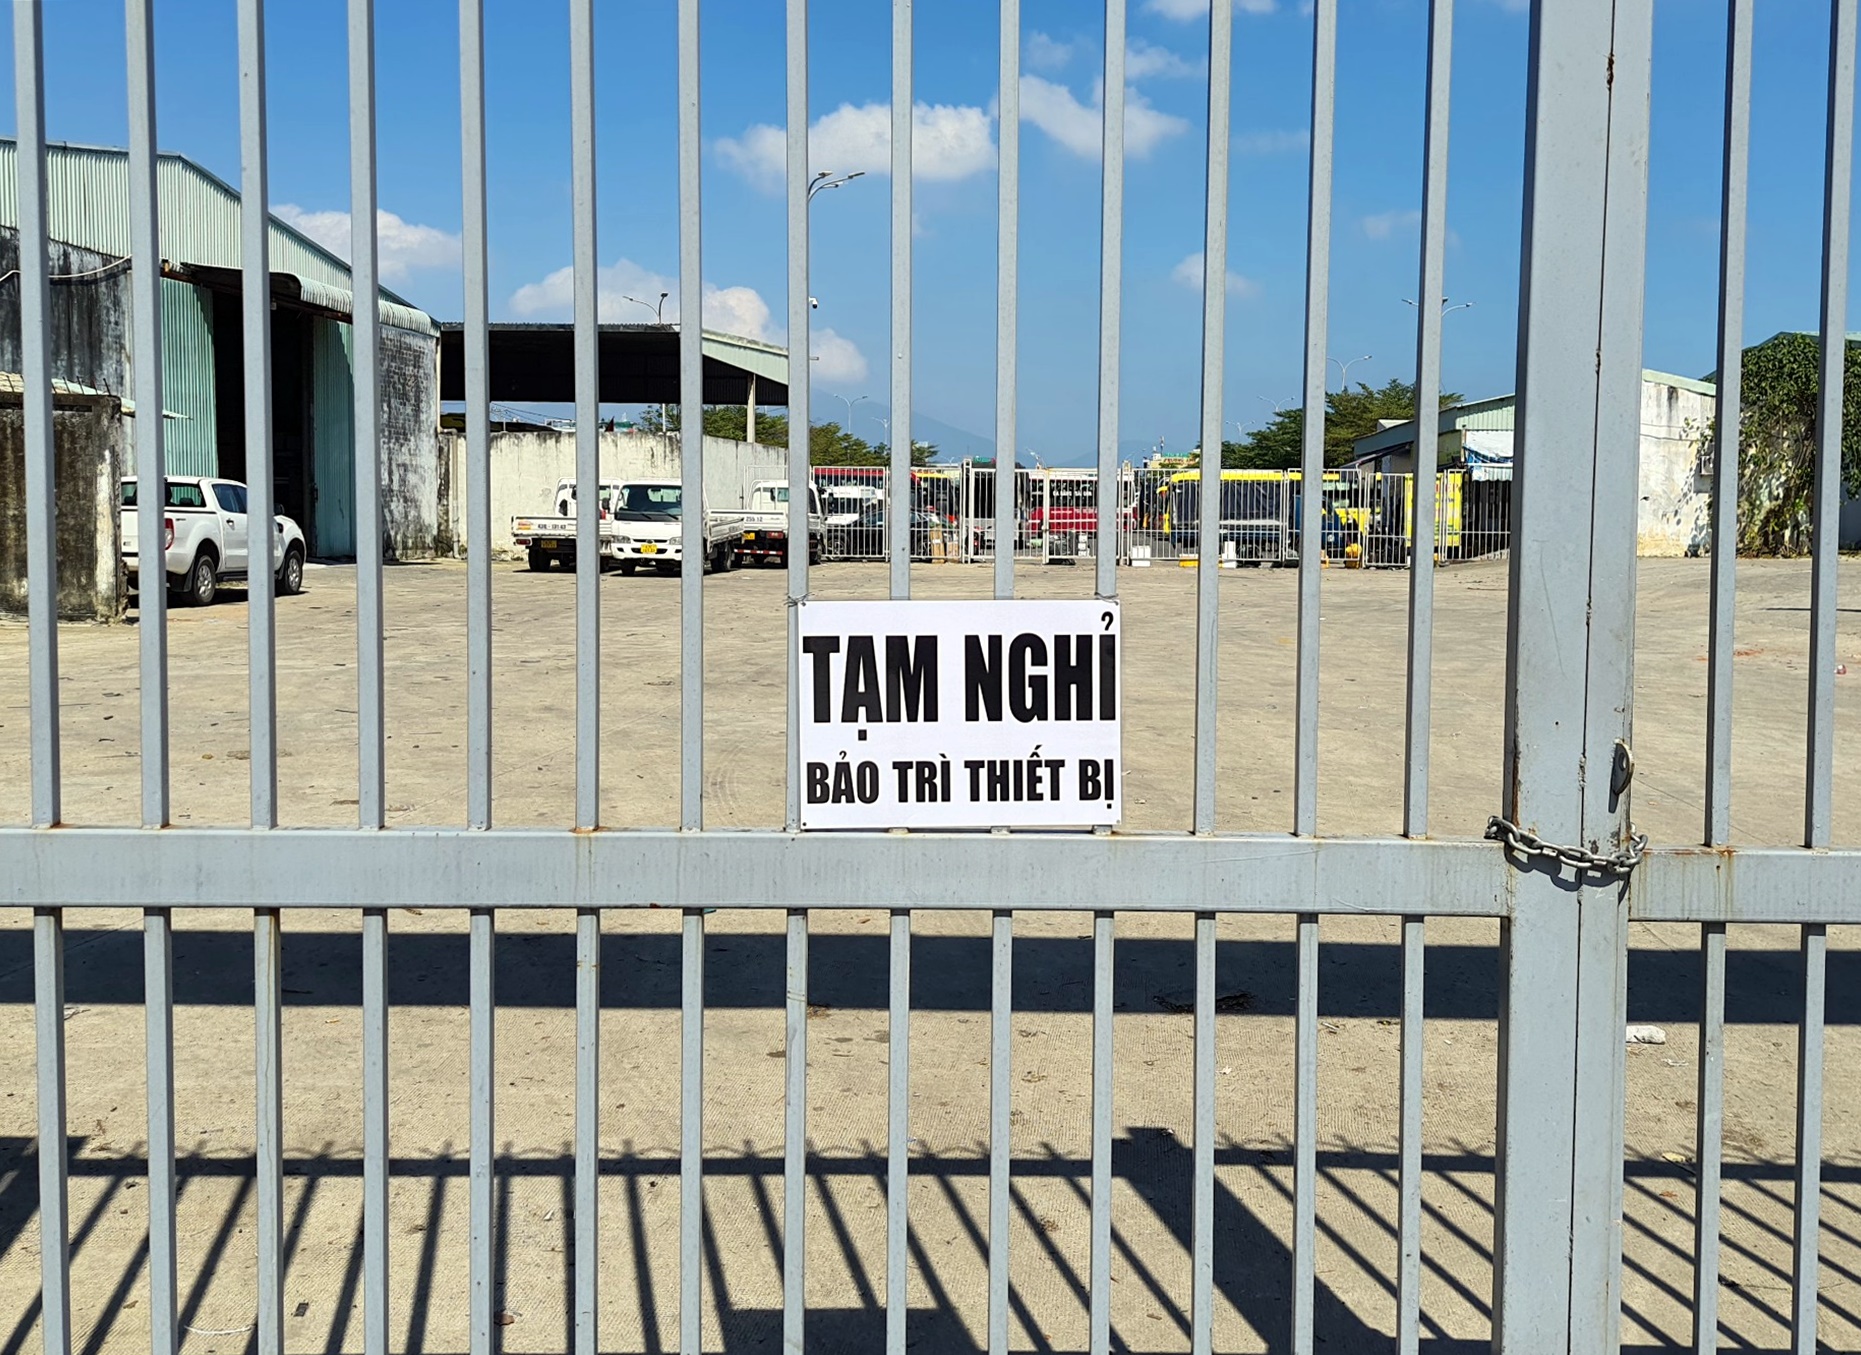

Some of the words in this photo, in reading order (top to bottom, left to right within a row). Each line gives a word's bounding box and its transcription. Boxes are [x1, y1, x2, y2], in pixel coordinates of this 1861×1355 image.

[802, 635, 938, 741] TẠM
[964, 611, 1116, 723] NGHỈ
[806, 750, 880, 804] BẢO
[892, 753, 951, 803] TRÌ
[964, 745, 1066, 802] THIẾT
[1079, 759, 1114, 809] BỊ
